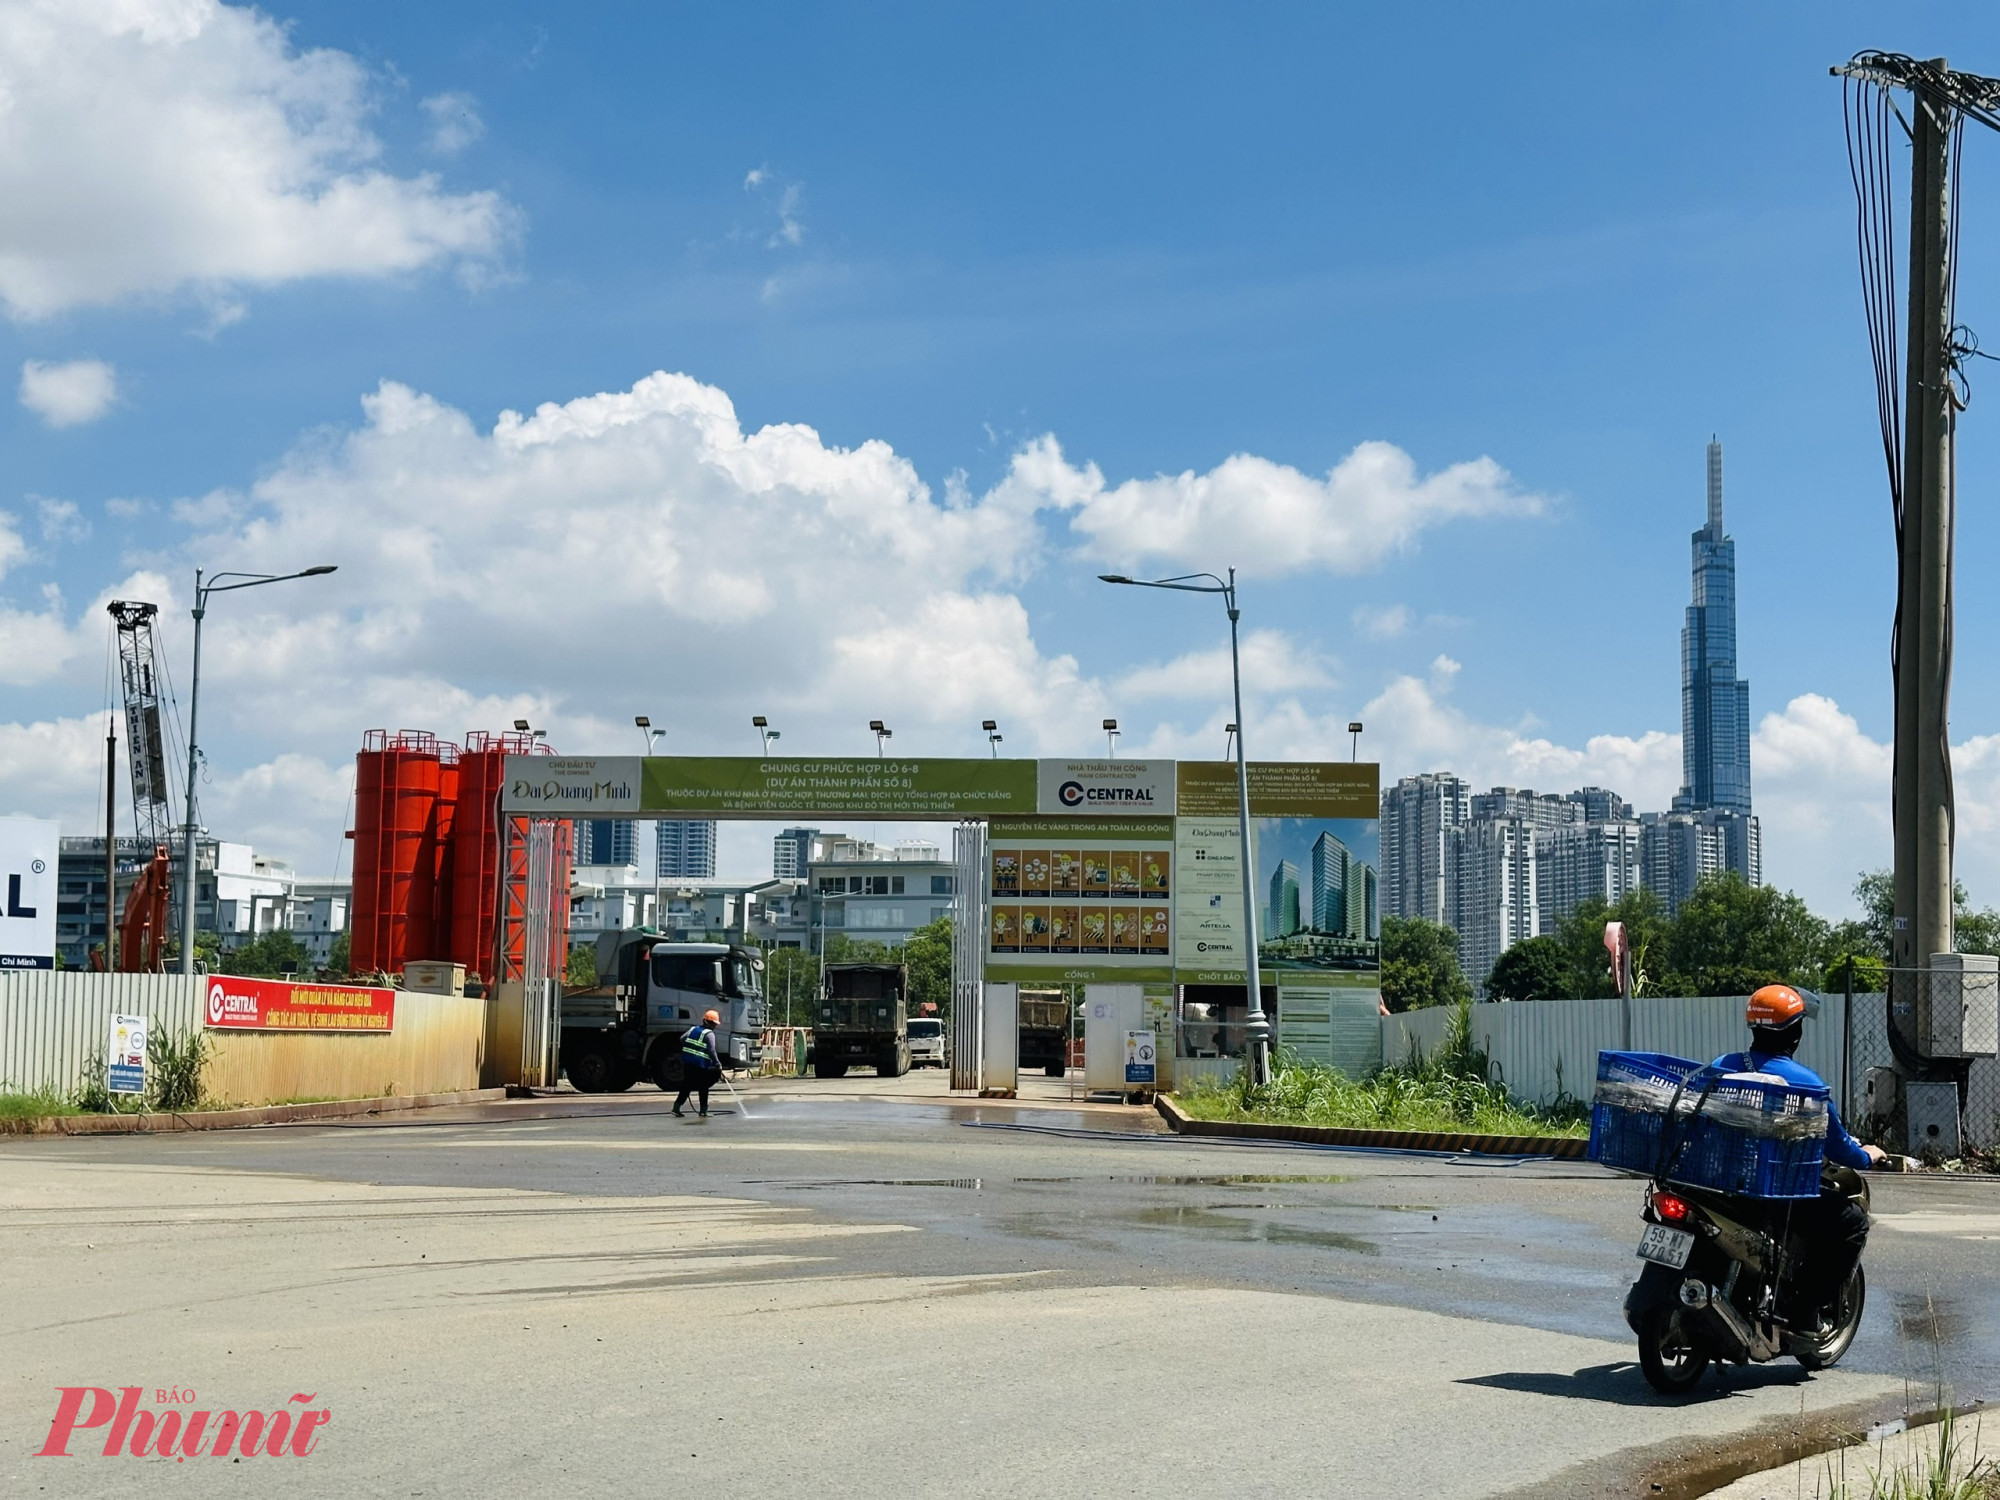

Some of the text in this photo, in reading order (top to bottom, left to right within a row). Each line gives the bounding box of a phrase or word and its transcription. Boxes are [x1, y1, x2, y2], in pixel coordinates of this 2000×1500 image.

[760, 762, 918, 776] CHUNG CƯ PHỨC HỢP LÔ 6-8
[1068, 764, 1147, 772] NHÀ THẦU THI CÔNG
[766, 778, 788, 788] (DỰ
[790, 778, 806, 788] ÁN
[809, 778, 847, 788] THÀNH
[884, 777, 898, 788] SỐ
[902, 778, 912, 788] 8)
[543, 780, 593, 802] Quang
[594, 780, 631, 799] Minh
[666, 789, 694, 798] THUỘC
[697, 790, 709, 798] DỰ
[711, 789, 722, 798] ÁN
[724, 790, 740, 798] KHU
[742, 790, 760, 798] NHÀ
[762, 790, 770, 798] Ở
[770, 790, 792, 798] PHỨC
[816, 790, 850, 799] THƯƠNG
[870, 792, 890, 801] DỊCH
[892, 792, 904, 801] VỤ
[930, 792, 948, 802] HỢP
[963, 791, 986, 800] CHỨC
[988, 791, 1012, 800] NĂNG
[1086, 788, 1154, 800] CENTRAL
[735, 801, 756, 810] BỆNH
[758, 801, 776, 810] VIỆN
[806, 800, 815, 809] TẾ
[864, 802, 878, 810] ĐÔ
[880, 803, 892, 811] THỊ
[894, 802, 910, 810] MỚI
[912, 802, 928, 810] THỦ
[930, 802, 954, 810] THIÊM
[1033, 823, 1048, 831] TẮC
[1049, 823, 1069, 831] VÀNG
[1071, 823, 1096, 831] TRONG
[1097, 823, 1108, 831] AN
[2, 958, 36, 966] Chí Minh
[1064, 970, 1090, 978] CỔNG
[1198, 972, 1221, 980] CHỐT
[224, 995, 258, 1013] CENTRAL
